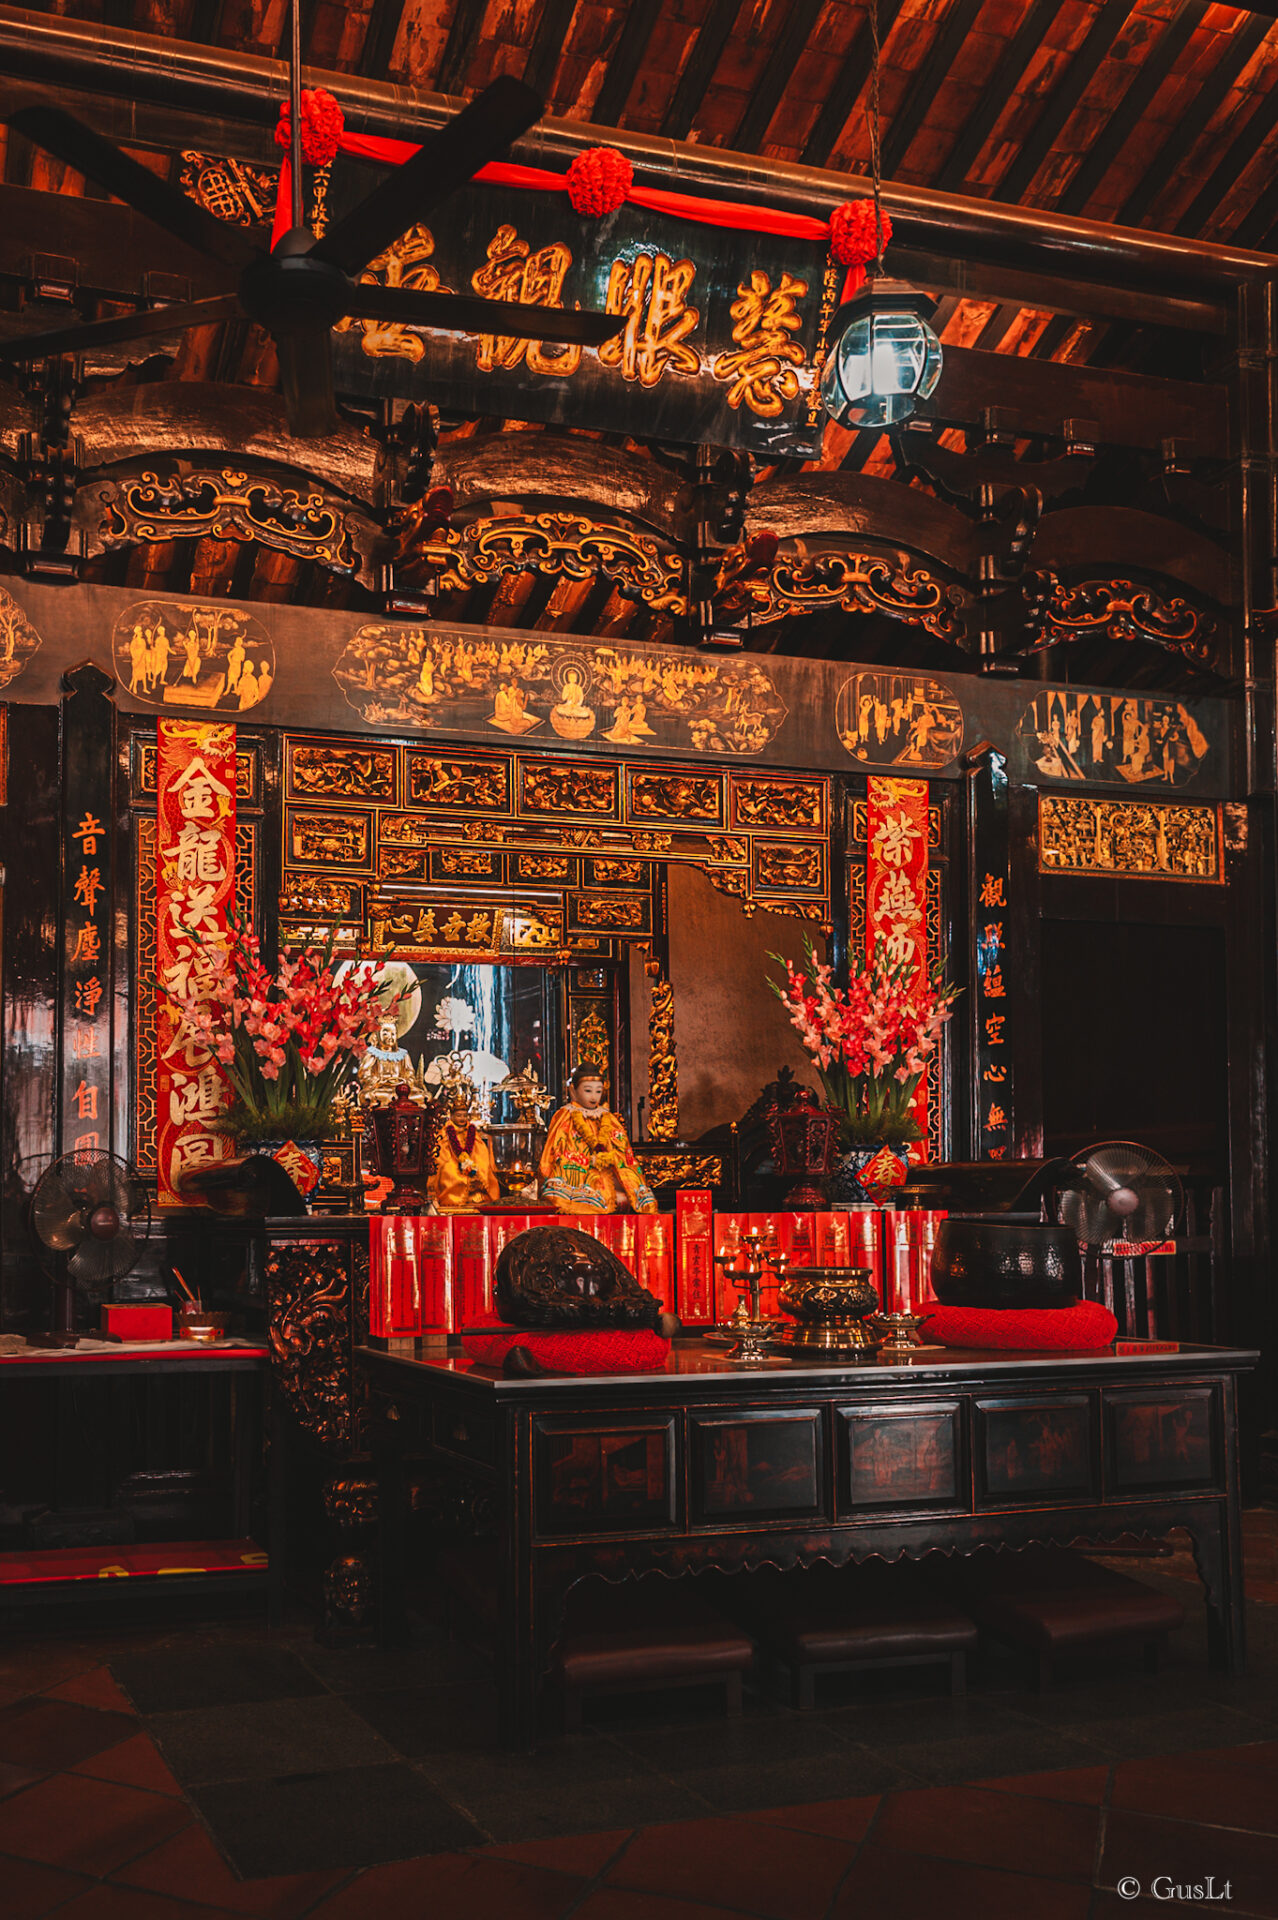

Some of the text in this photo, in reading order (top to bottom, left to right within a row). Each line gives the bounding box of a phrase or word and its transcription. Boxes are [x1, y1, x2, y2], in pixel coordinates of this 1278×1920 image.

[311, 160, 332, 240] 六甲政事
[71, 812, 106, 1195] 音聲塵淨性自圓
[873, 1154, 900, 1186] 春
